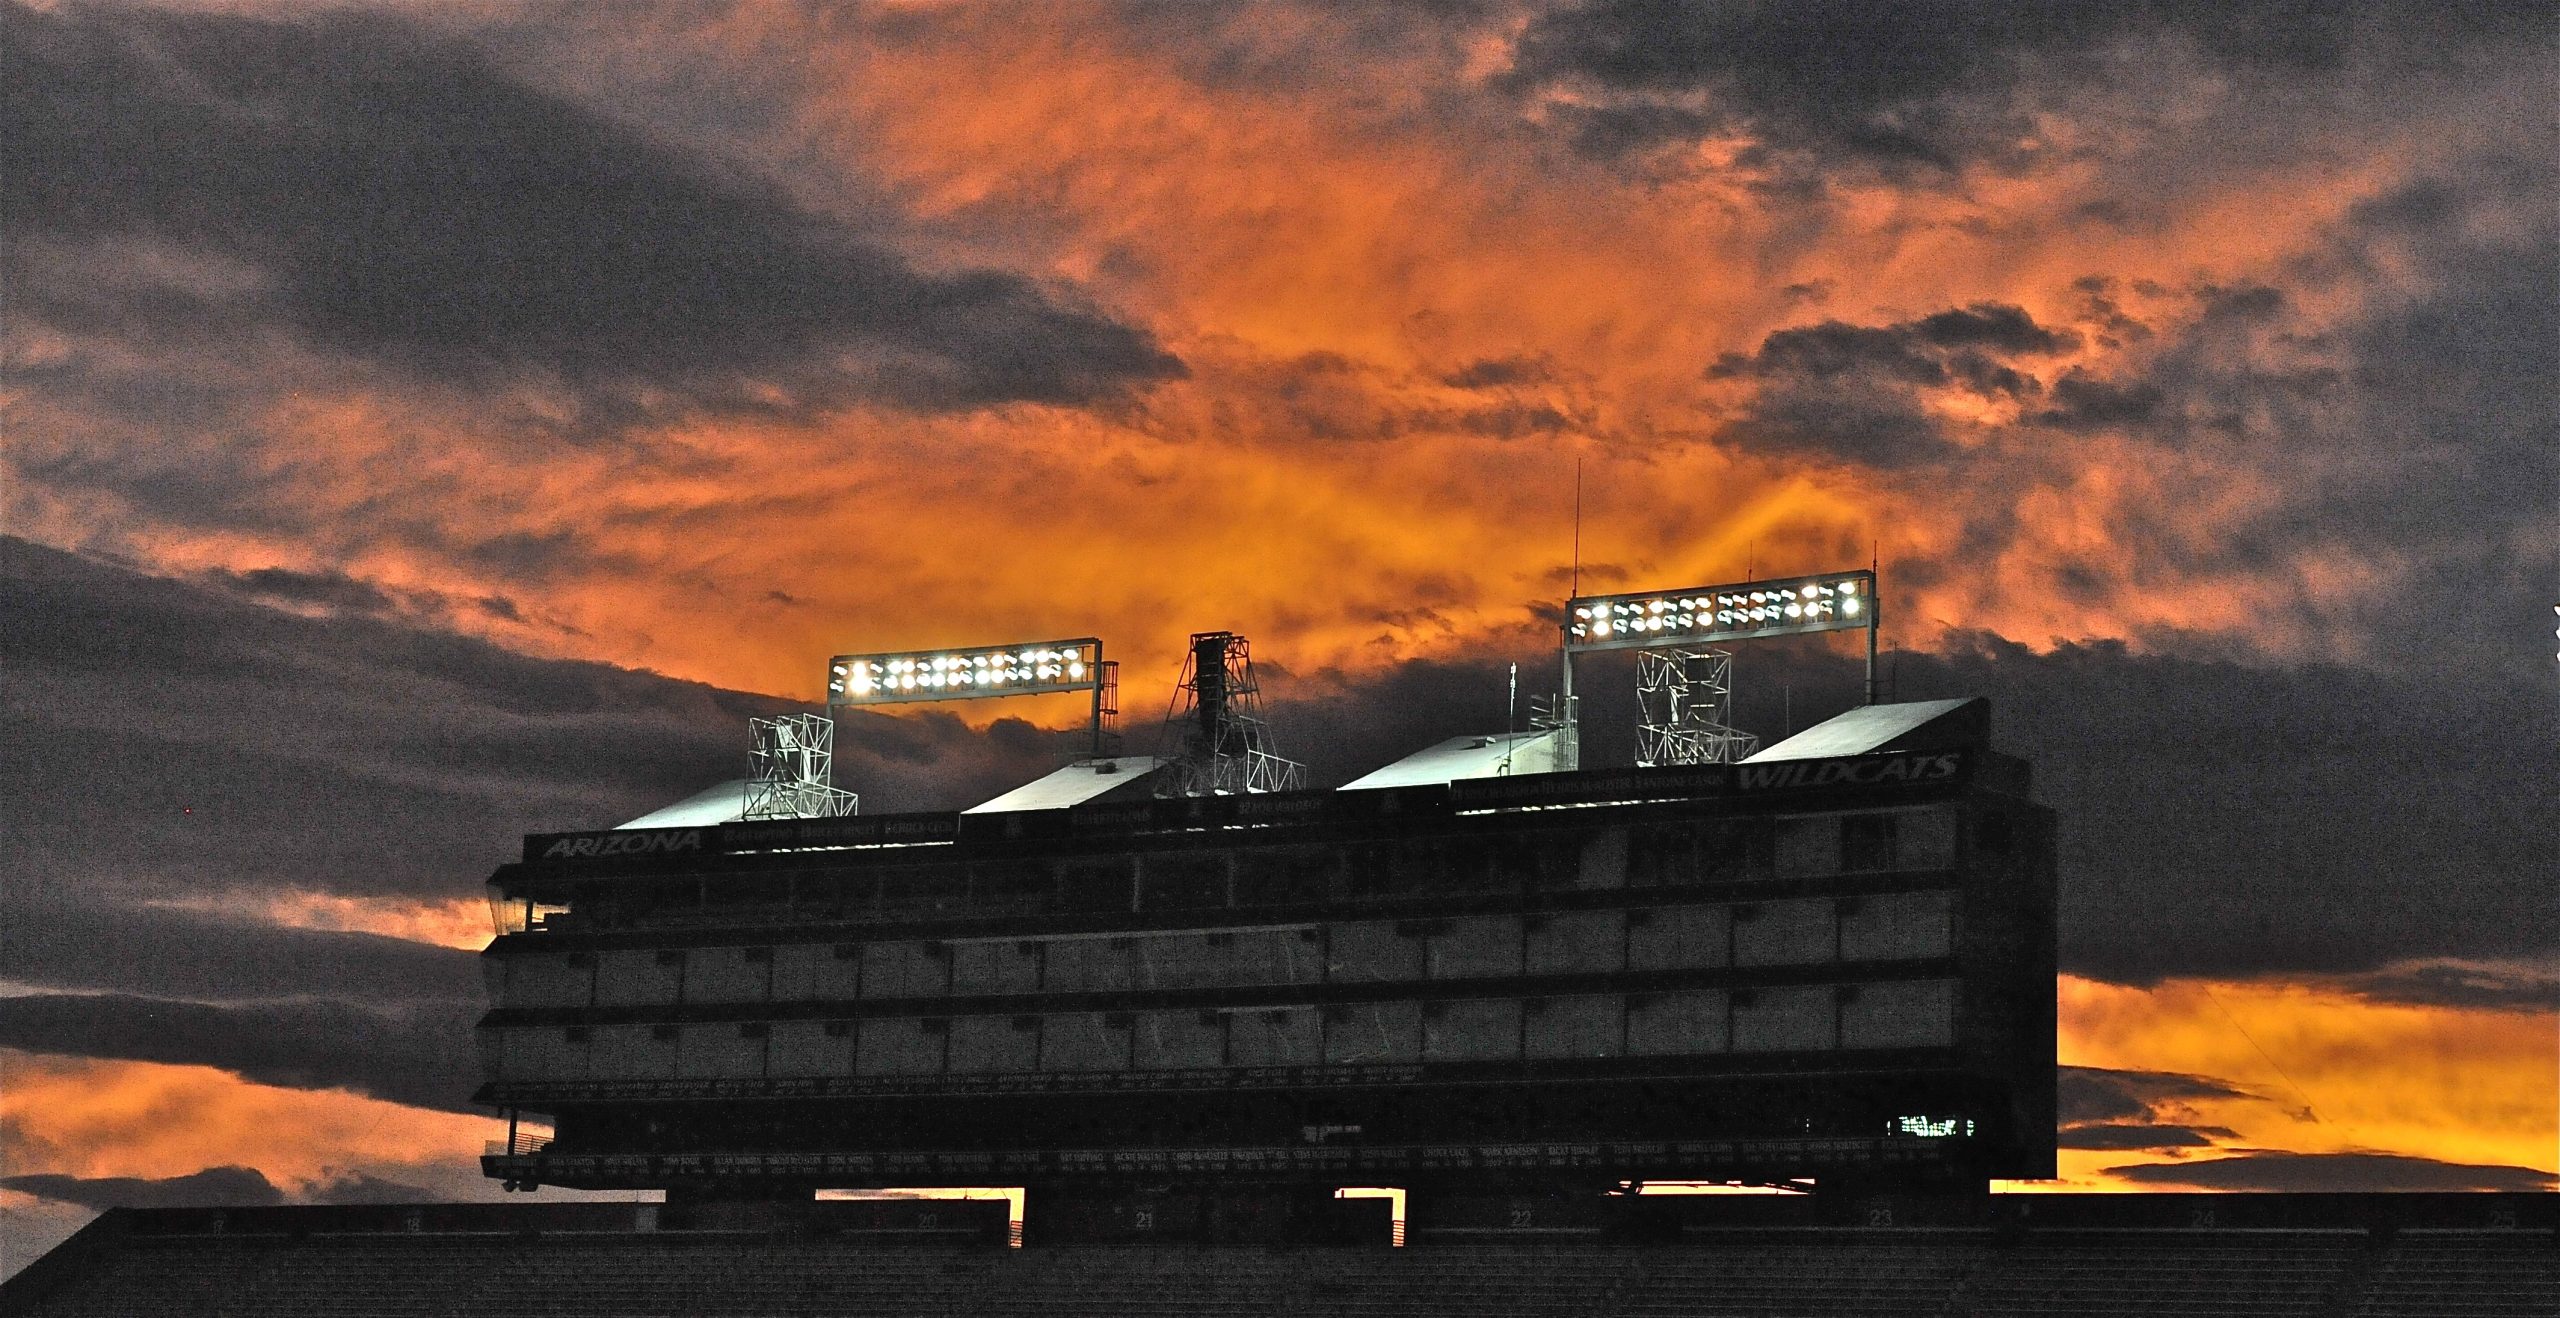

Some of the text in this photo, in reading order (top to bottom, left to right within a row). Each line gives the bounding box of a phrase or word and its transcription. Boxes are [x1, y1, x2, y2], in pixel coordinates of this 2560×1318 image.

[1739, 754, 1960, 790] WILDCATS
[543, 831, 701, 858] ARIZONA
[919, 1213, 937, 1230] 20
[1136, 1211, 1153, 1229] 21
[1511, 1210, 1531, 1228] 22
[1870, 1209, 1892, 1227] 23
[2191, 1210, 2215, 1229] 24
[2490, 1210, 2515, 1230] 25
